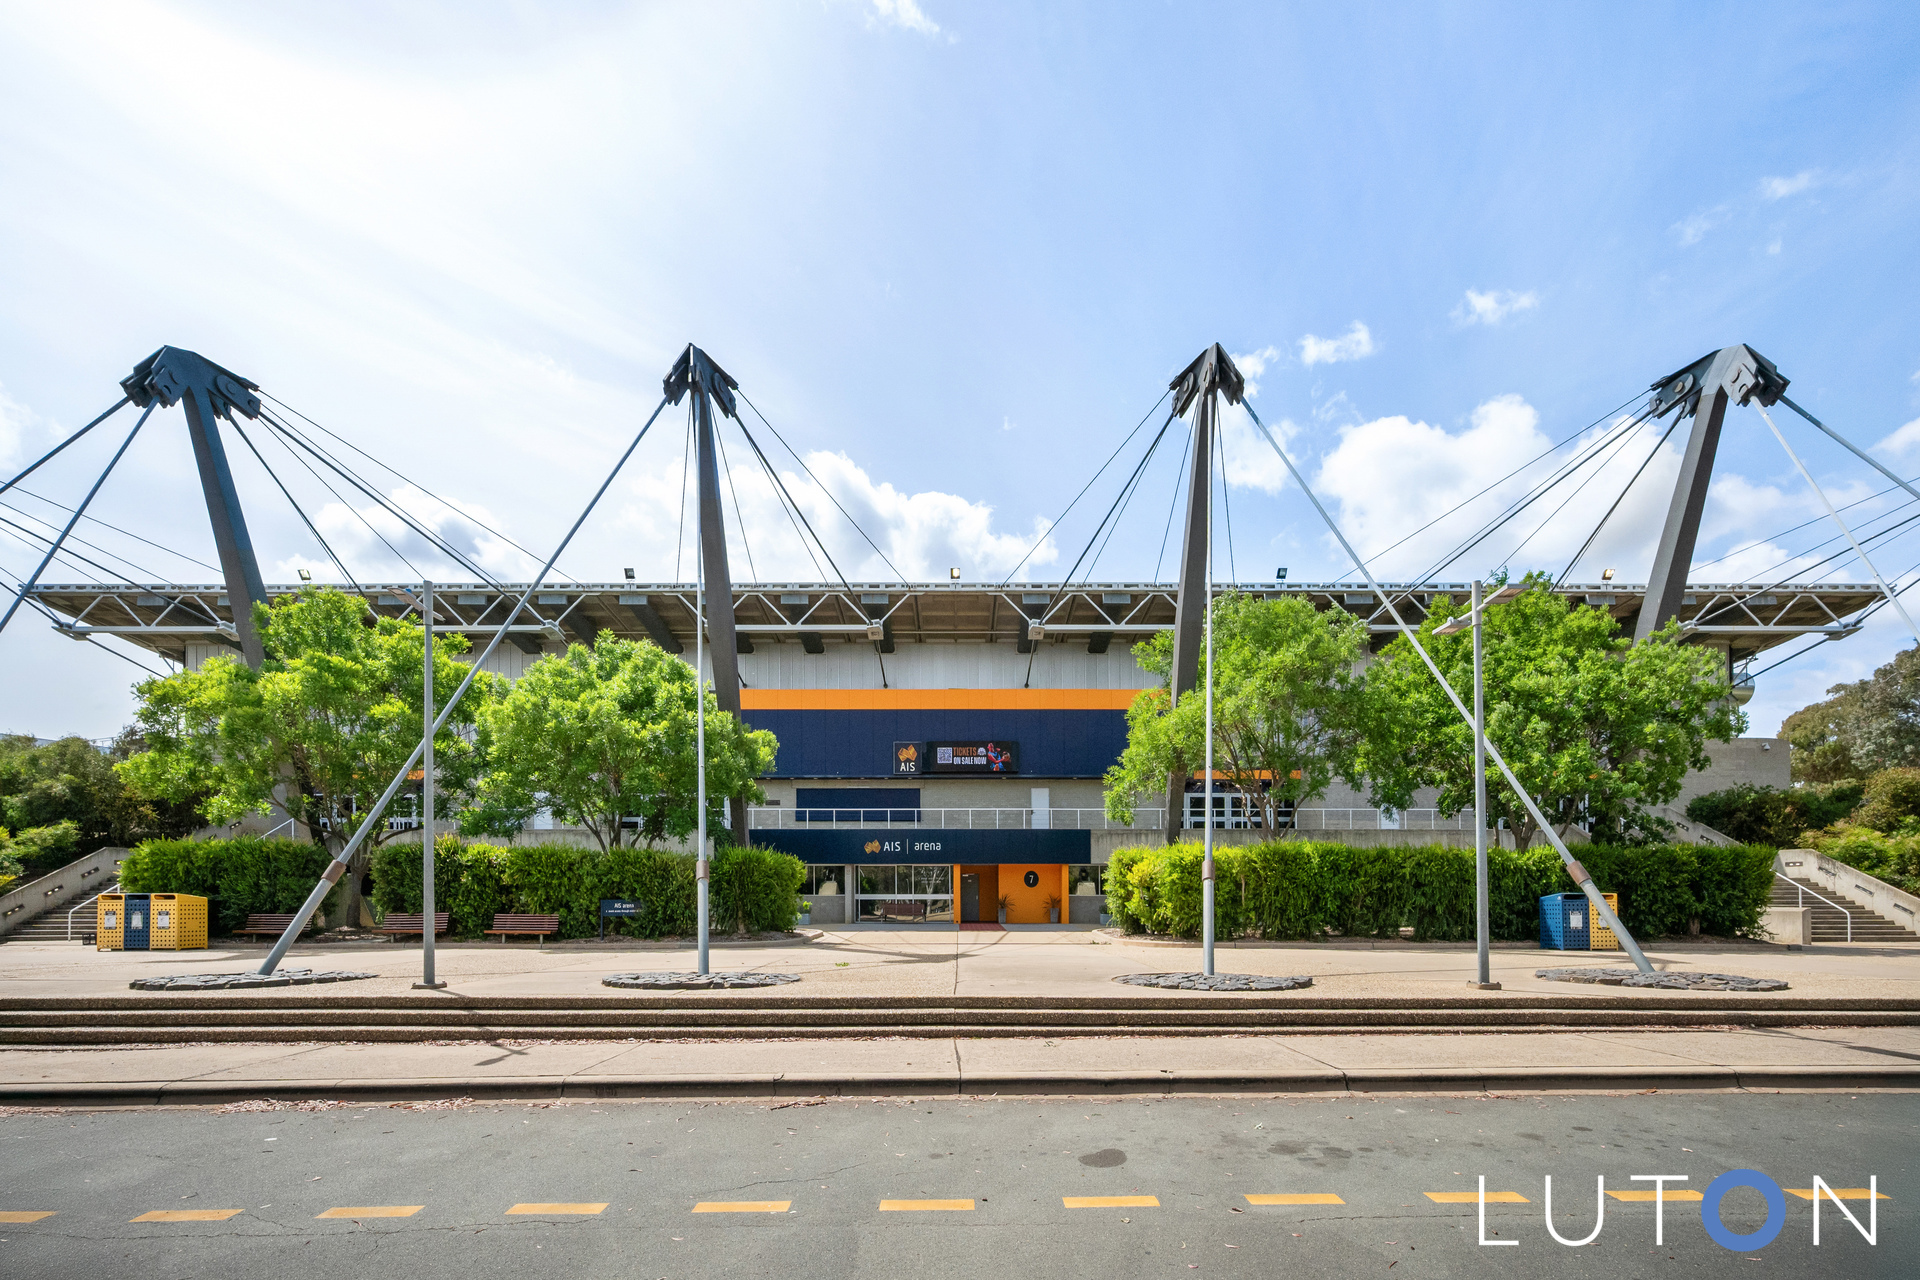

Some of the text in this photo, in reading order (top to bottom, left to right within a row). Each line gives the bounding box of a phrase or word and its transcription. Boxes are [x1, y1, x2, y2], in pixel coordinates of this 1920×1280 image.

[953, 747, 977, 756] TICKETS
[953, 757, 987, 765] ON SALE NOW
[900, 762, 916, 772] AIS
[883, 841, 942, 852] AIS arena
[1029, 875, 1034, 884] 7
